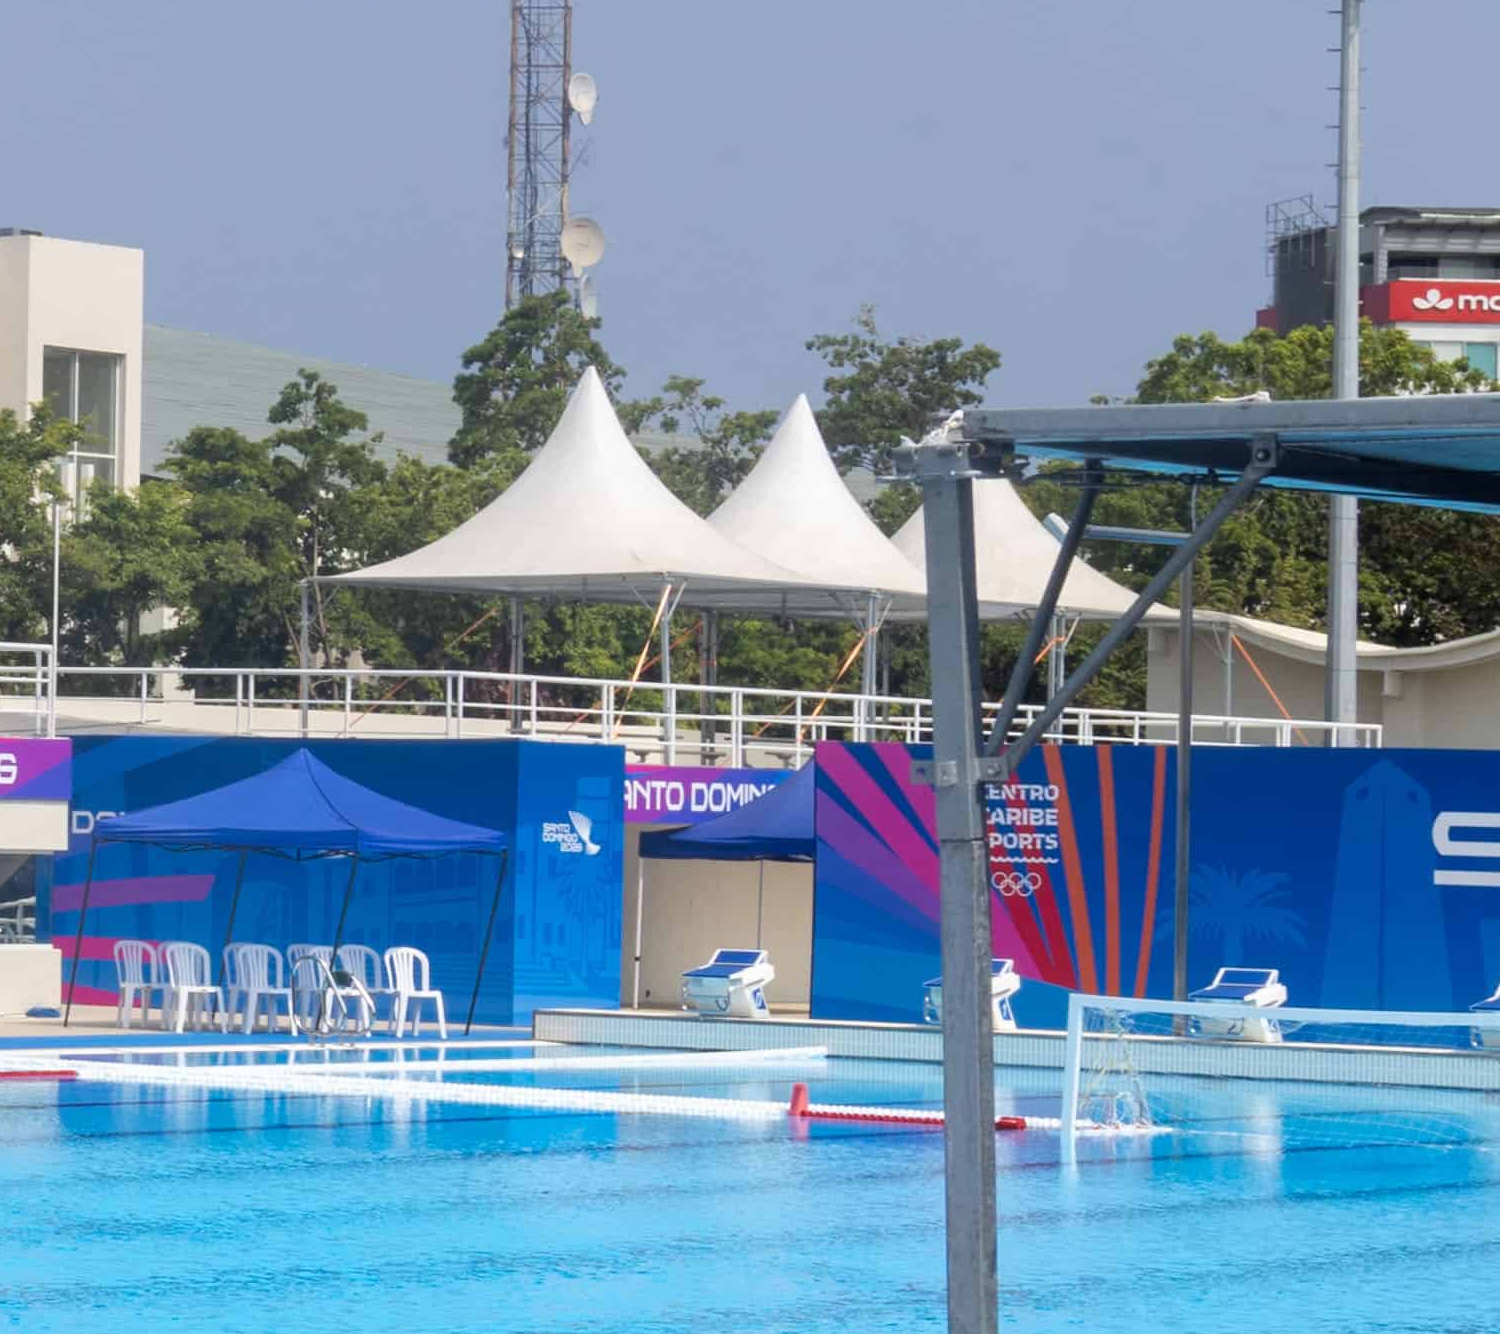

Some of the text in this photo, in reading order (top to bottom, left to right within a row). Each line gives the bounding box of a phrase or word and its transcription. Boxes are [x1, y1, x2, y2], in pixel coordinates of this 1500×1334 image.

[624, 780, 776, 812] NTO DOMIN
[985, 784, 1059, 800] ENTRO
[986, 807, 1059, 825] ARIBE
[988, 833, 1059, 849] PORTS
